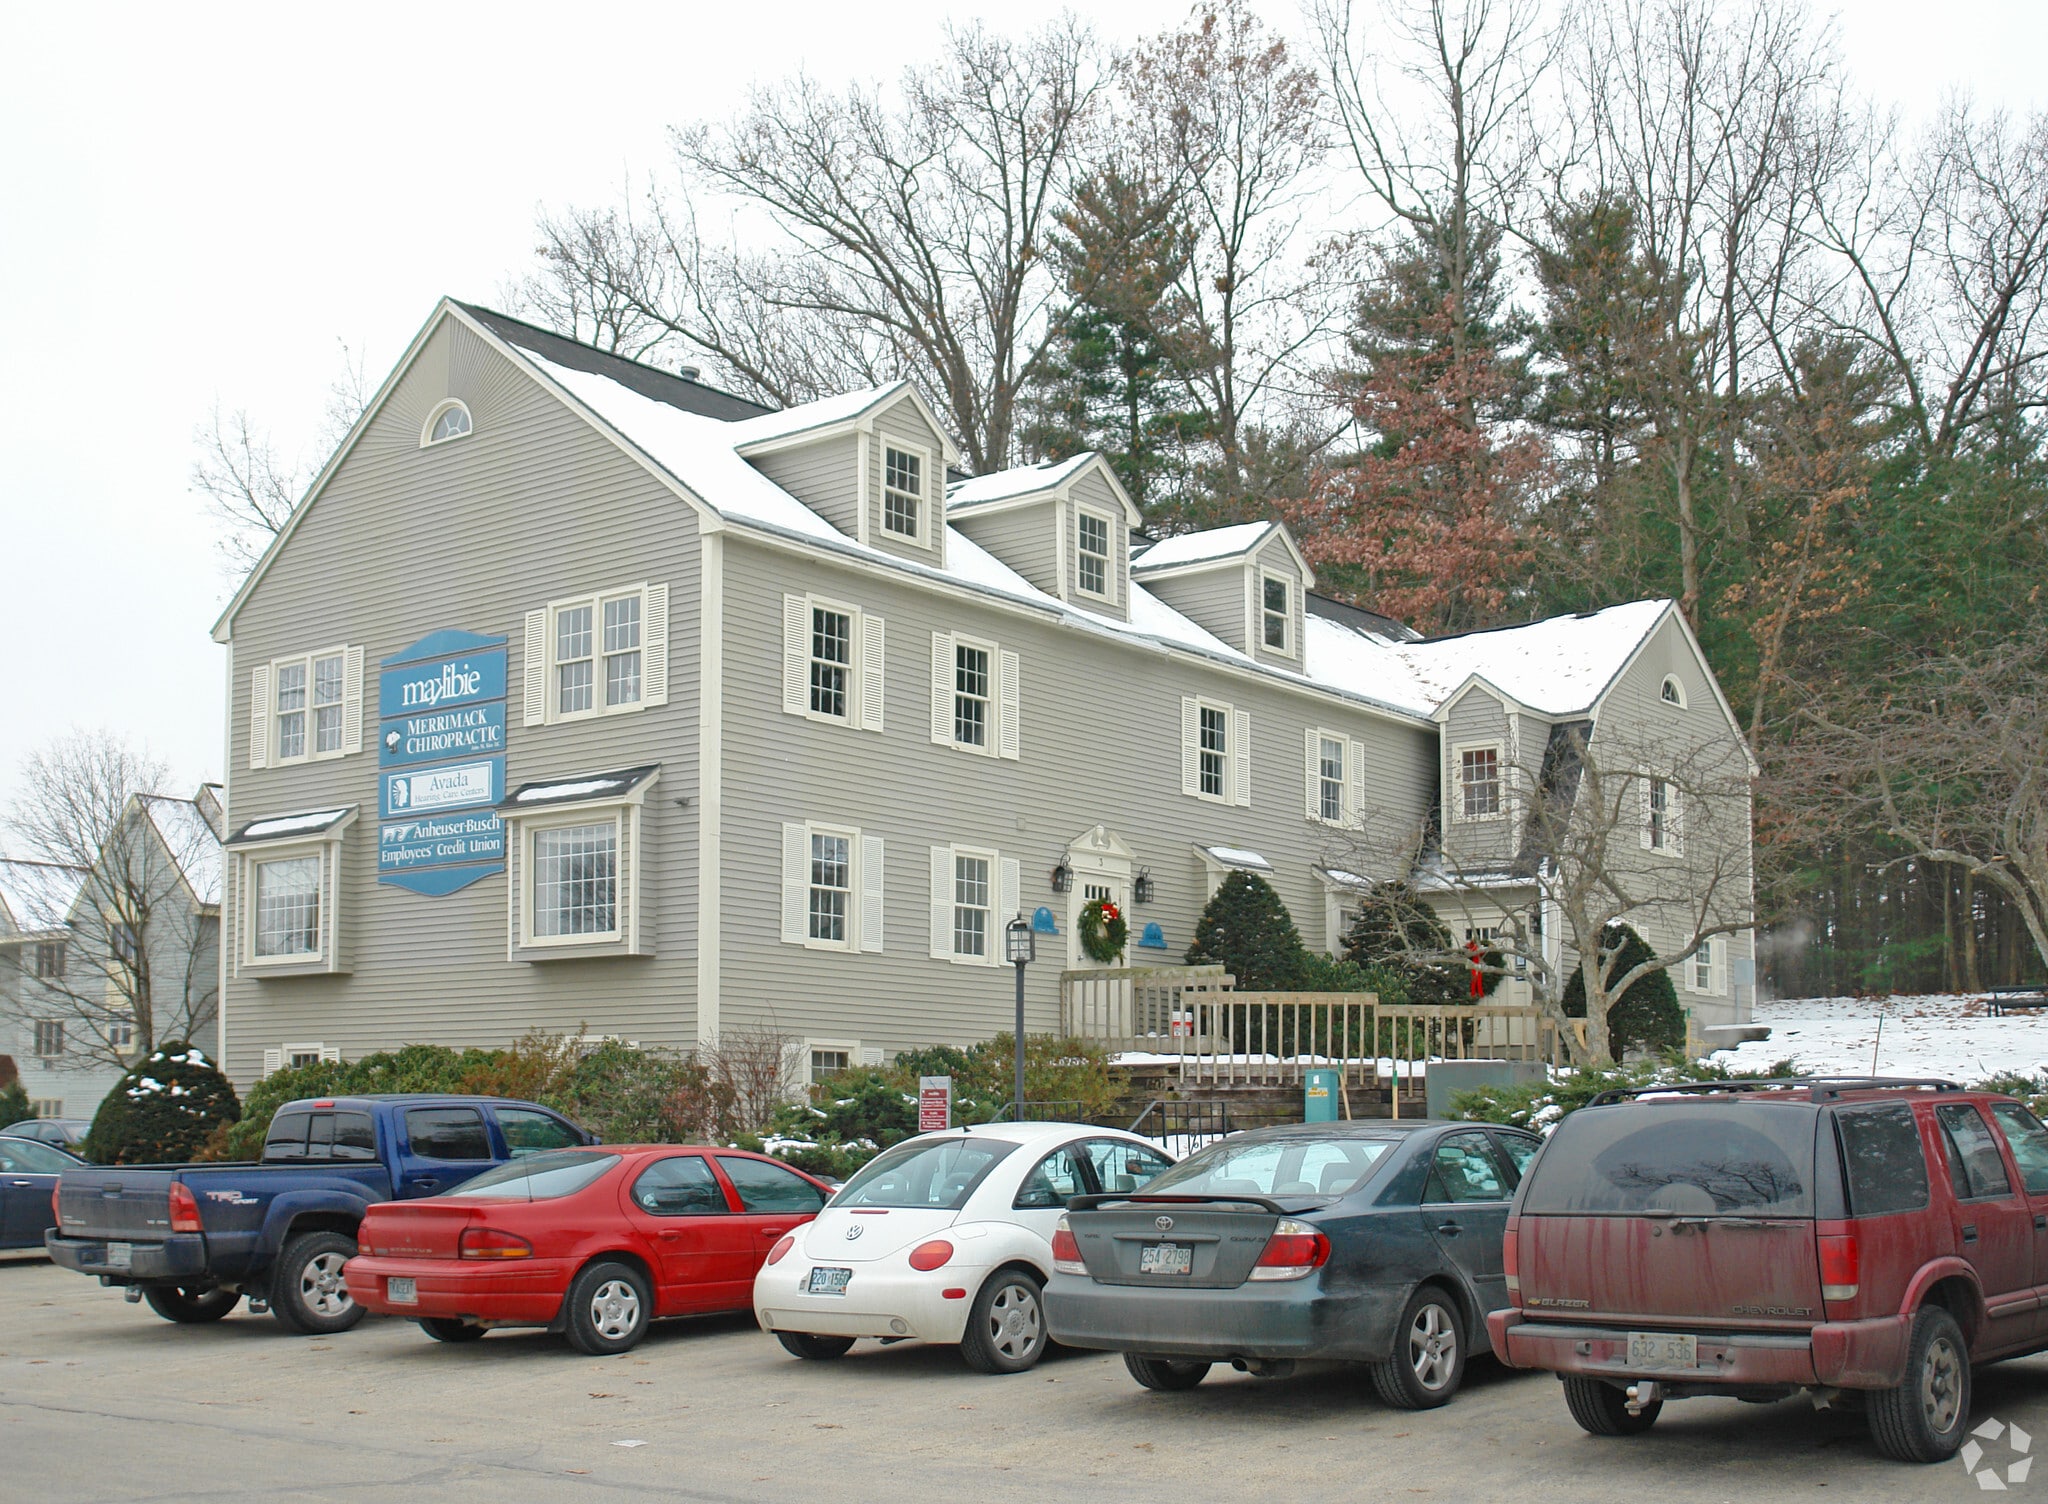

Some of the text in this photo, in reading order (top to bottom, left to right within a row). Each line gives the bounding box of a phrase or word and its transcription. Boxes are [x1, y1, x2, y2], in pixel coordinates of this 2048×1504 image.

[406, 725, 501, 754] CHIROPRACTIC
[430, 773, 468, 791] Avada
[415, 787, 484, 803] Hearing Care Centers
[413, 813, 500, 838] Anheuser-Busch
[437, 838, 466, 856] Credit
[470, 835, 500, 852] Union
[1094, 857, 1103, 867] 3
[206, 1190, 242, 1202] TRD
[1142, 1249, 1190, 1265] 254 2798
[1541, 1297, 1590, 1309] BLAZER
[1732, 1305, 1812, 1317] CHEVROLET
[1632, 1340, 1691, 1360] 632 536
